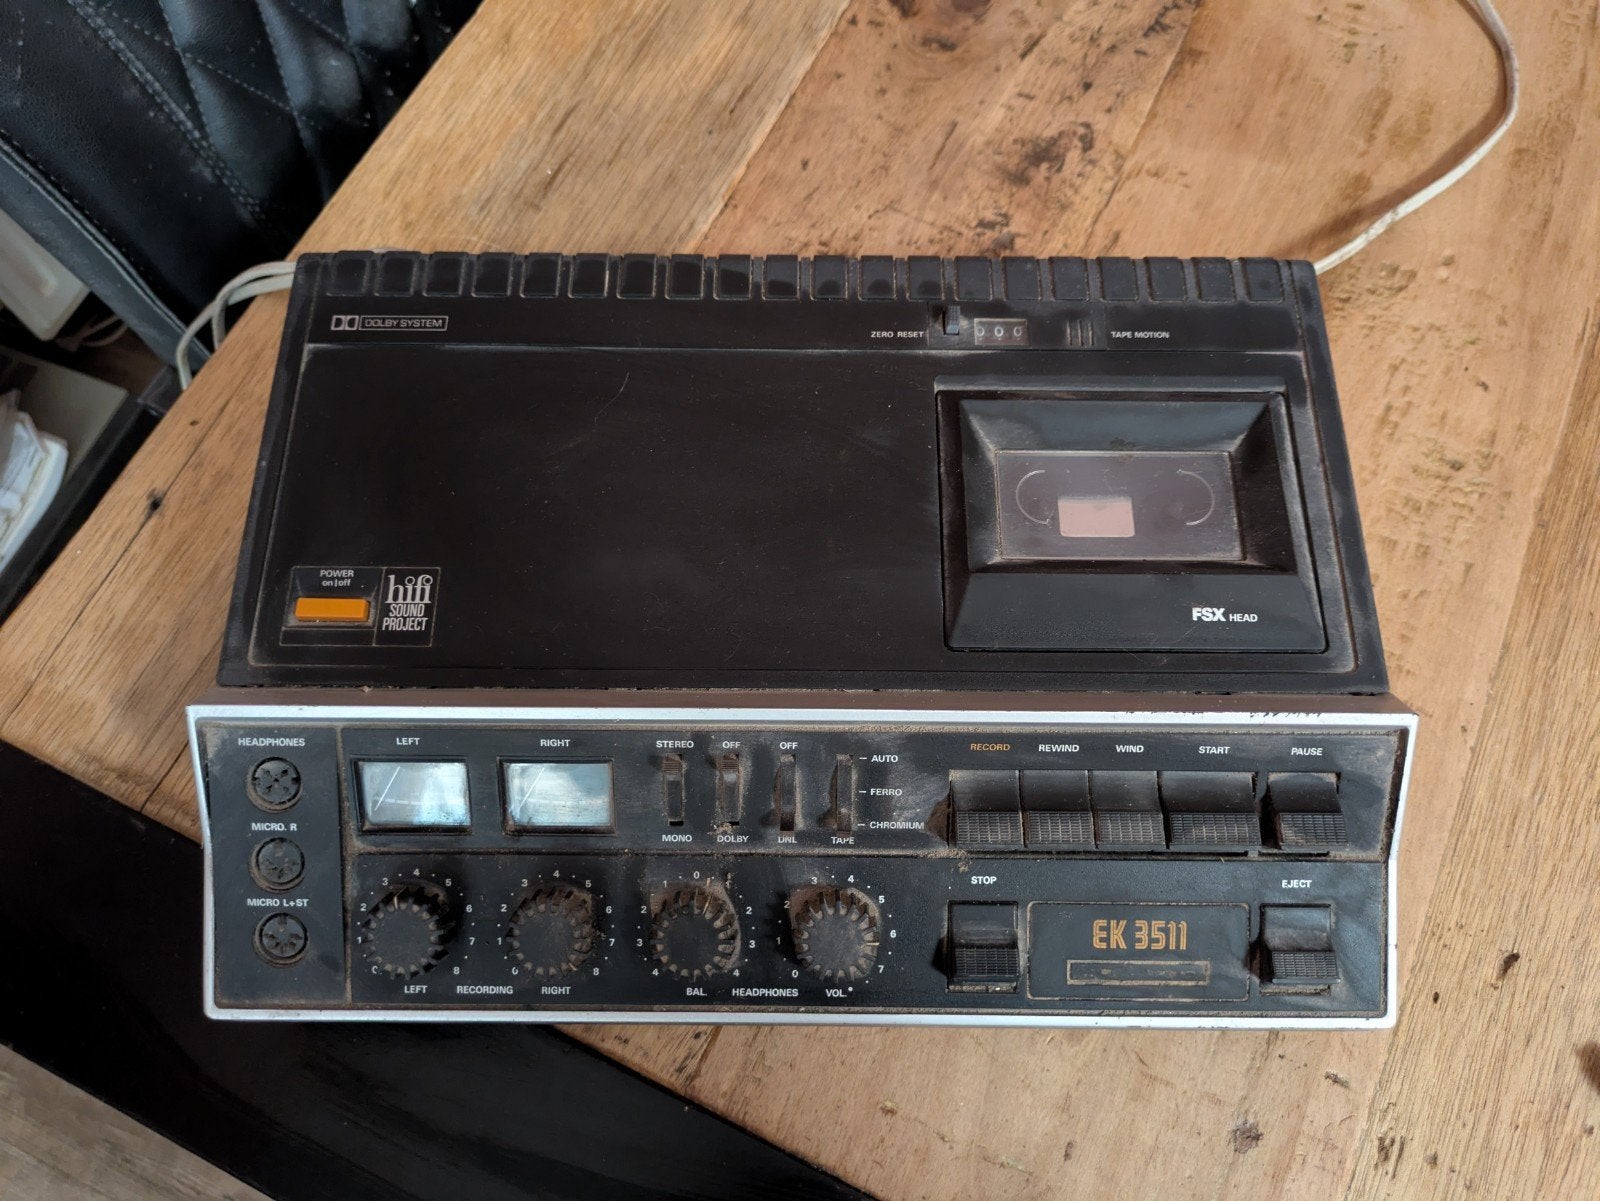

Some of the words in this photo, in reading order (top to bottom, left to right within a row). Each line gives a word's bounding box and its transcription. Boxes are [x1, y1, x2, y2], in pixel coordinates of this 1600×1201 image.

[365, 319, 399, 327] DOLBY
[400, 320, 442, 328] SYSTEM
[1111, 331, 1132, 339] TAPE
[1134, 331, 1170, 339] MOTION
[320, 569, 355, 578] POWER
[384, 574, 434, 604] hifi
[388, 603, 426, 618] SOUND
[1192, 607, 1227, 621] FSX
[1229, 613, 1258, 622] HEAD
[381, 617, 429, 631] PROJECT
[237, 737, 306, 747] HEADPHONES
[396, 737, 421, 746] LEFT
[540, 738, 571, 748] RIGHT
[656, 740, 695, 749] STEREO
[722, 741, 741, 749] OFF
[779, 741, 799, 750] OFF
[970, 743, 1011, 751] RECORD
[1038, 743, 1080, 752] REWIND
[1115, 744, 1144, 753] WIND
[1198, 746, 1231, 755] START
[1290, 747, 1323, 756] PAUSE
[871, 754, 899, 763] AUTO
[870, 788, 903, 796] FERRO
[251, 822, 287, 831] MICRO.
[290, 822, 298, 831] R
[869, 821, 925, 830] CHROMIUM
[661, 834, 693, 843] MONO
[716, 834, 750, 843] DOLBY
[830, 836, 855, 845] TAPE
[413, 868, 420, 876] 4
[553, 870, 560, 878] 4
[693, 870, 700, 879] 0
[382, 877, 389, 886] 3
[445, 878, 452, 887] 5
[521, 878, 528, 887] 3
[585, 879, 592, 888] 5
[811, 876, 818, 884] 3
[847, 875, 855, 883] 4
[971, 875, 997, 885] STOP
[1281, 879, 1312, 888] EJECT
[247, 898, 280, 907] MICRO
[283, 899, 309, 907] L+ST
[878, 895, 885, 904] 5
[360, 902, 367, 911] 2
[465, 904, 473, 913] 6
[500, 903, 508, 912] 2
[605, 906, 613, 914] 6
[640, 905, 647, 914] 2
[745, 906, 752, 915] 2
[889, 929, 897, 938] 6
[1092, 919, 1127, 949] EK
[1134, 920, 1188, 950] 3511
[469, 937, 476, 945] 7
[609, 938, 616, 947] 7
[636, 938, 643, 947] 3
[748, 940, 756, 949] 3
[453, 966, 460, 975] 8
[511, 966, 519, 975] 0
[592, 968, 600, 976] 8
[651, 968, 659, 976] 4
[733, 968, 740, 977] 4
[791, 969, 799, 978] 0
[878, 965, 885, 973] 7
[404, 985, 428, 994] LEFT
[456, 985, 514, 995] RECORDING
[541, 986, 571, 995] RIGHT
[732, 988, 799, 997] HEADPHONES
